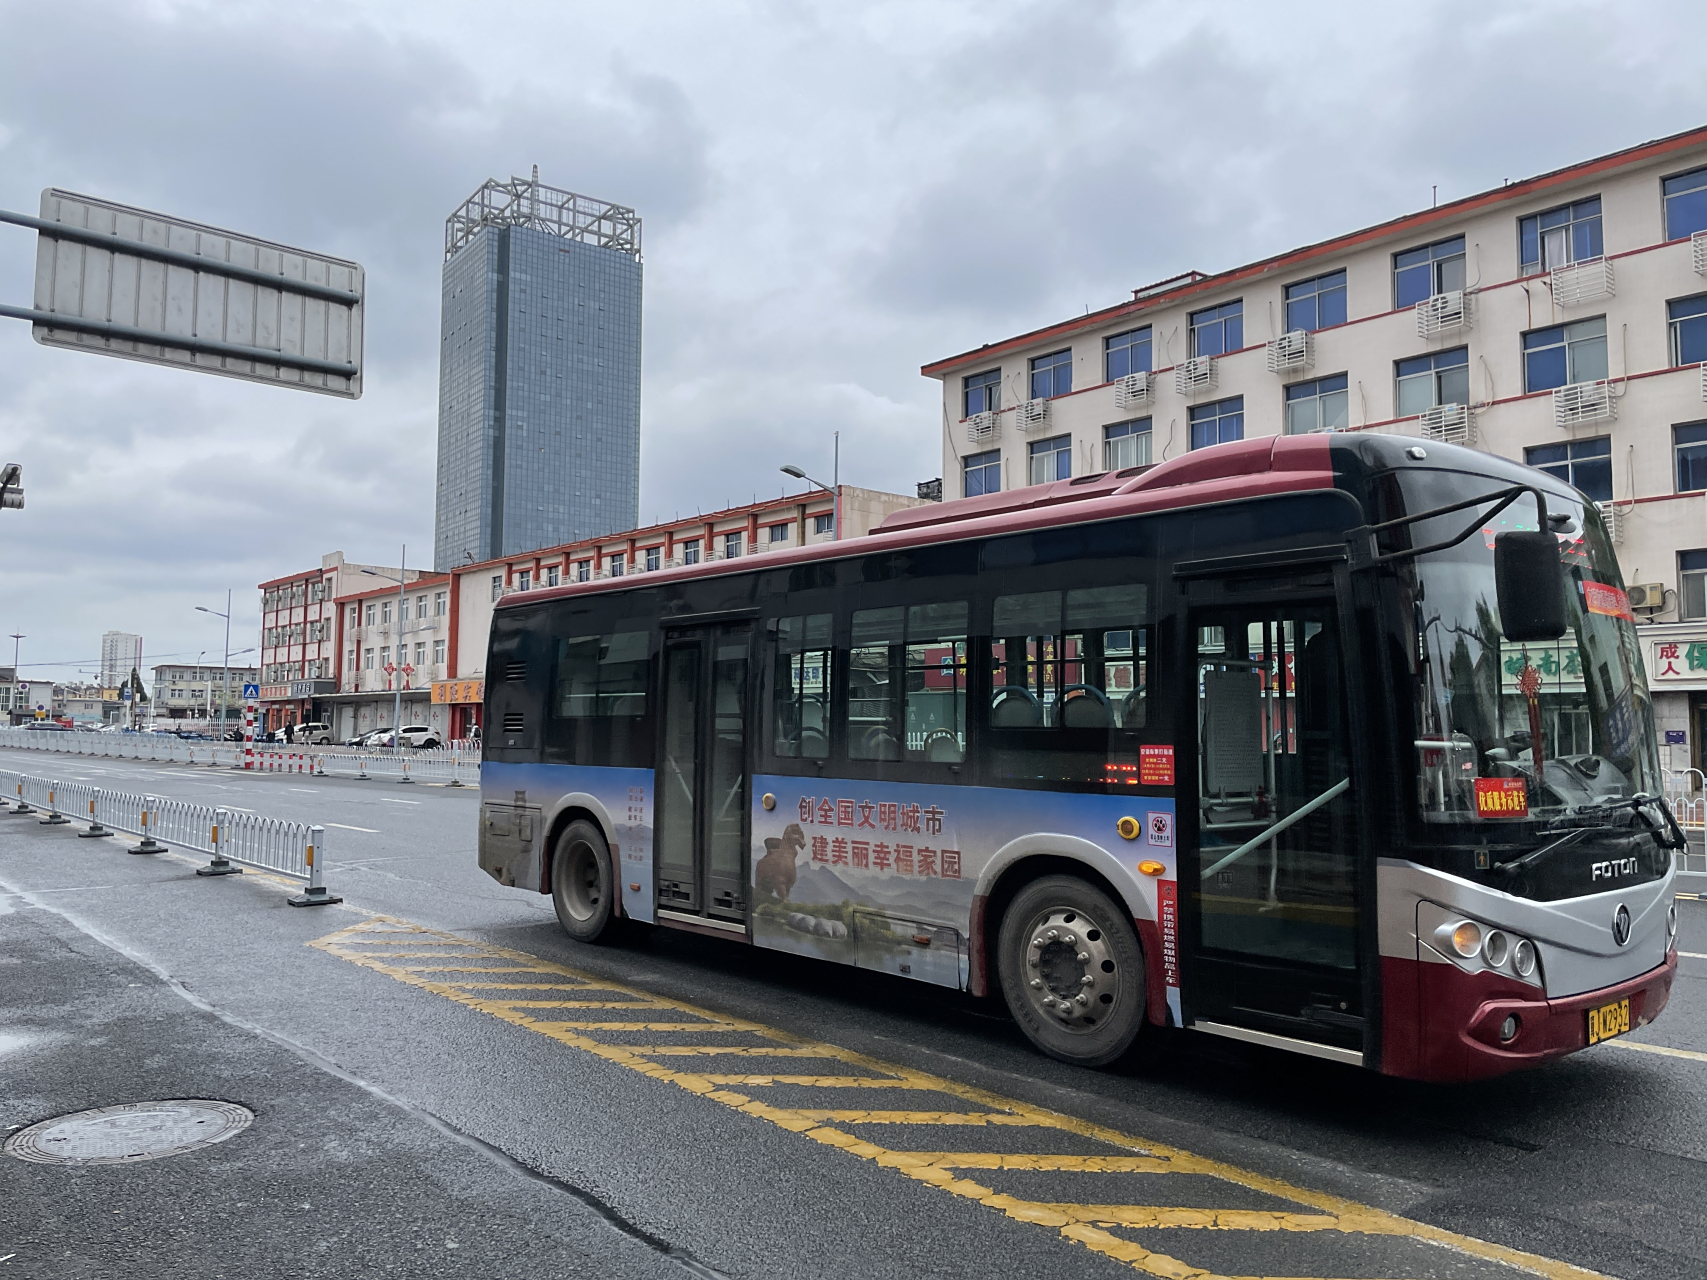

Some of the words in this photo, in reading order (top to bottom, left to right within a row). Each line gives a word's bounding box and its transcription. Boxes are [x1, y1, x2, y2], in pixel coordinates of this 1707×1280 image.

[1659, 643, 1681, 676] 成人
[798, 796, 945, 836] 创全国文明城市
[1479, 790, 1525, 811] 优质服务示范车
[811, 835, 963, 881] 建美丽幸福家园
